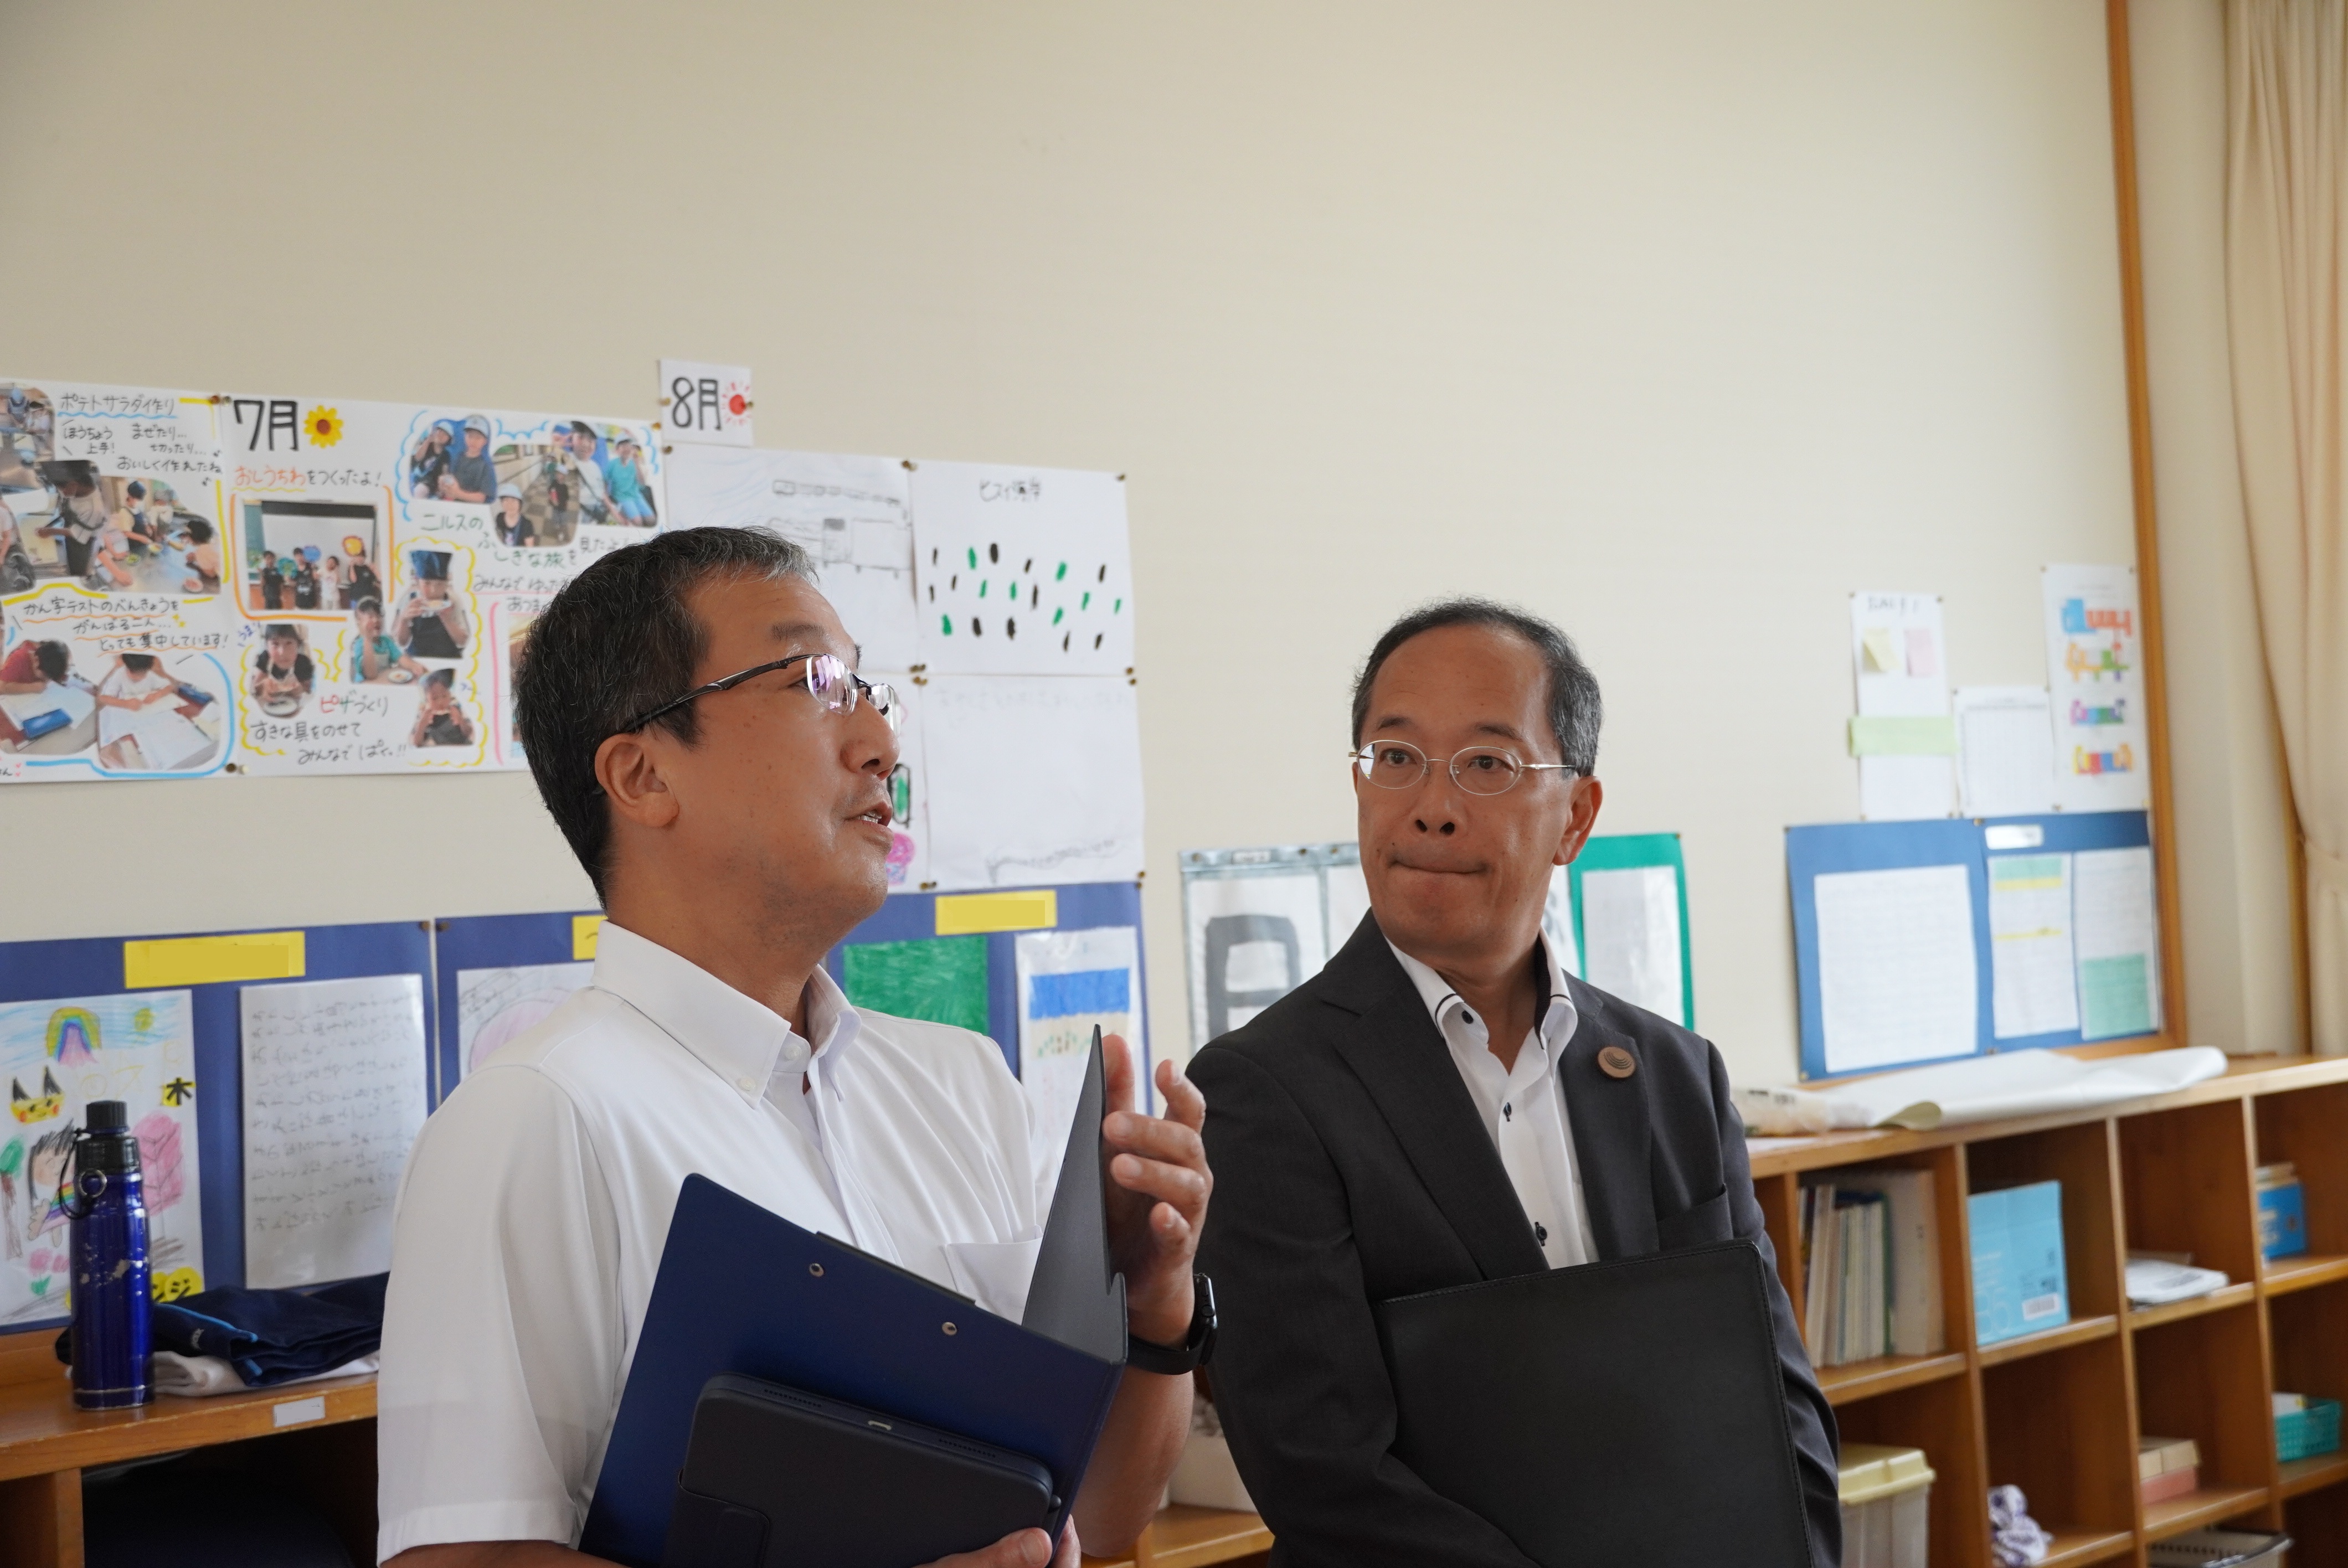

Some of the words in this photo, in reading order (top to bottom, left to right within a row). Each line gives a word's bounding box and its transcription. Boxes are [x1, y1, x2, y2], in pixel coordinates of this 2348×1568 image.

[61, 393, 176, 415] ポテトサラダ作り
[672, 376, 722, 431] 8月
[63, 424, 113, 440] ほうちょう
[233, 399, 300, 452] 7月
[117, 456, 222, 473] おいしく作れたね
[24, 596, 179, 616] かん字テストのべんきょうを
[320, 689, 389, 718] ピザづくり
[250, 720, 361, 742] すきな具をのせて
